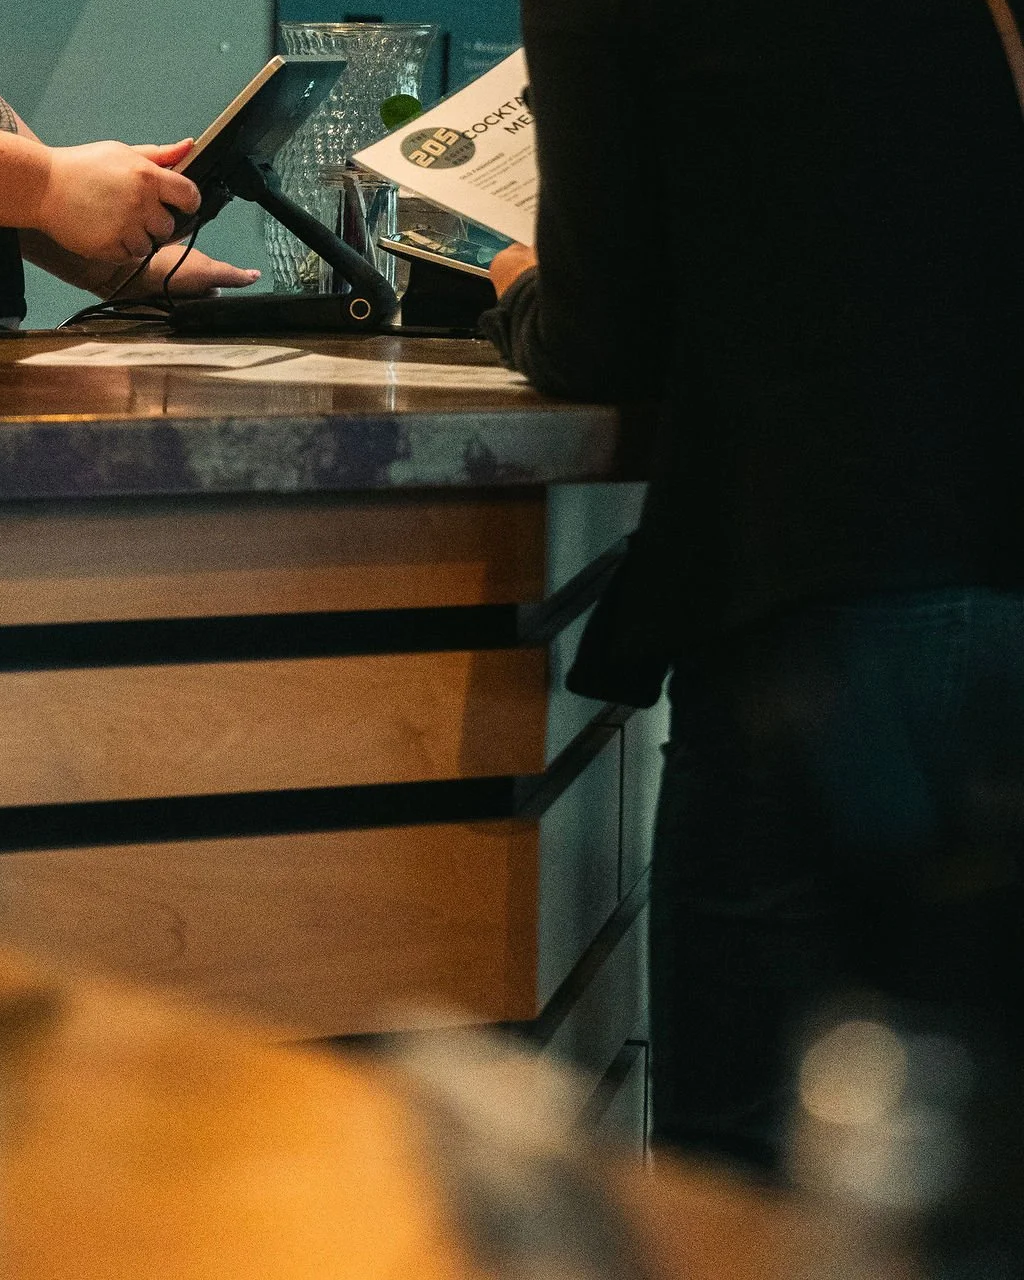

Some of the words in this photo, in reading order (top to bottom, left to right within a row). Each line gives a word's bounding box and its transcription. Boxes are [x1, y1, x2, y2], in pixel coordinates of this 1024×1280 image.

[462, 96, 525, 140] COCKTA
[503, 111, 534, 135] ME
[408, 128, 460, 168] 205
